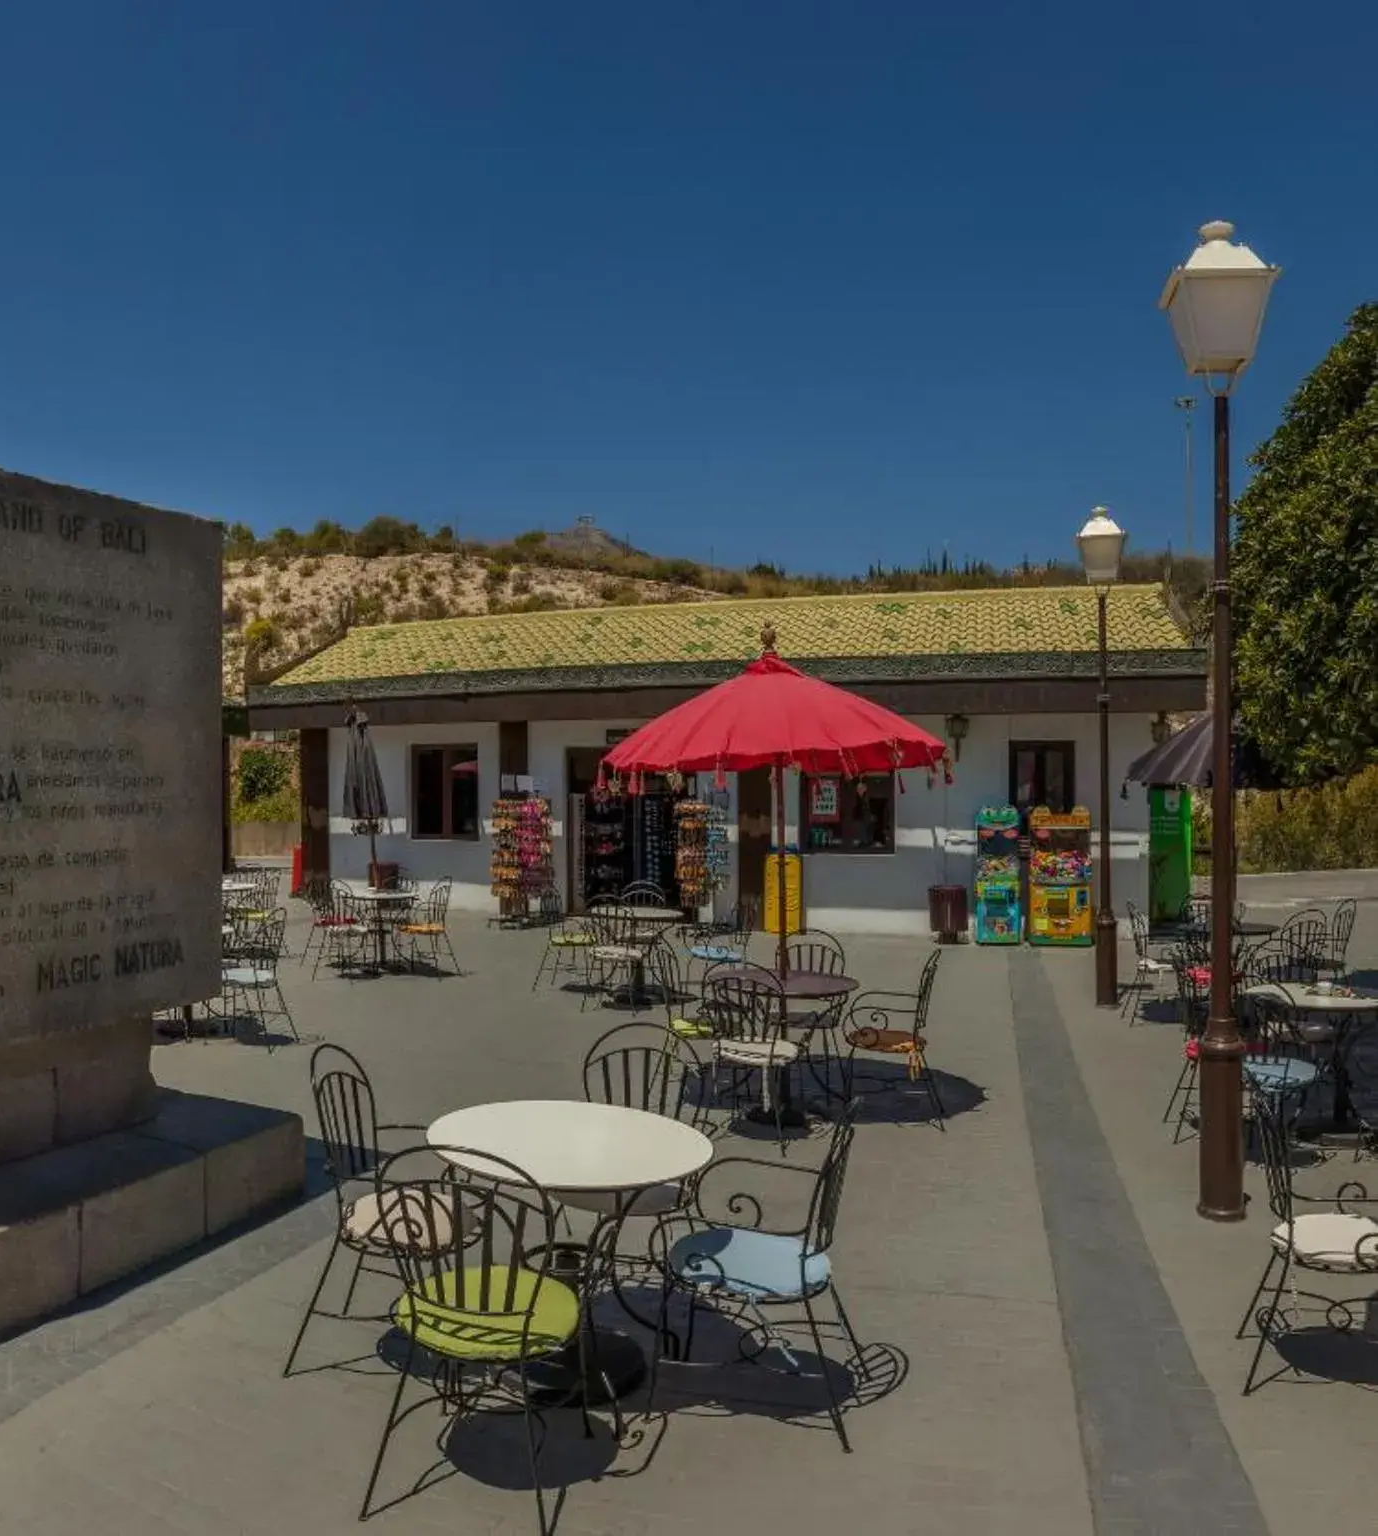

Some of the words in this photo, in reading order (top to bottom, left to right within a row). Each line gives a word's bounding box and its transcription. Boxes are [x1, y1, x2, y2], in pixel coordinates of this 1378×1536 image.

[58, 514, 87, 543] OF
[101, 519, 147, 556] BALI
[37, 952, 102, 995] MAGIC
[114, 937, 185, 977] NATURA
